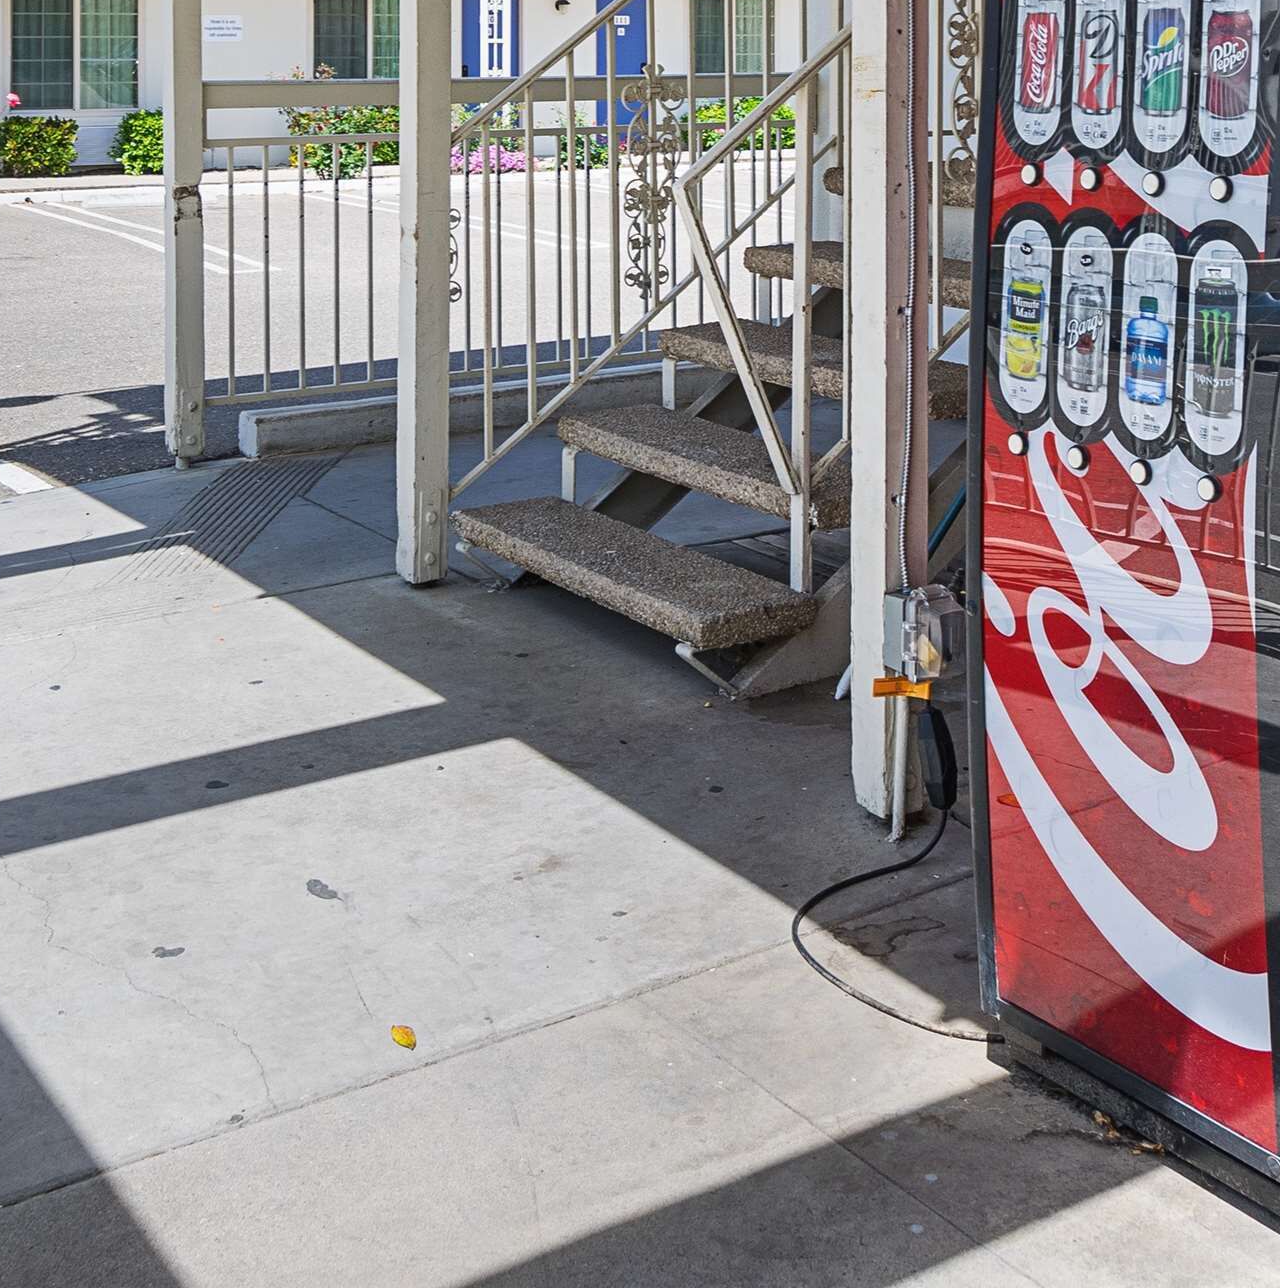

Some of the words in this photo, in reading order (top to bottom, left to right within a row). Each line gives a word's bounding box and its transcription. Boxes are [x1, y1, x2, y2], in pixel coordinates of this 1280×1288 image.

[1026, 21, 1049, 104] Coca-Cola
[1141, 41, 1184, 81] Sprite
[1213, 44, 1248, 73] Pepper
[1222, 42, 1239, 57] Dr
[1015, 306, 1036, 319] Maid
